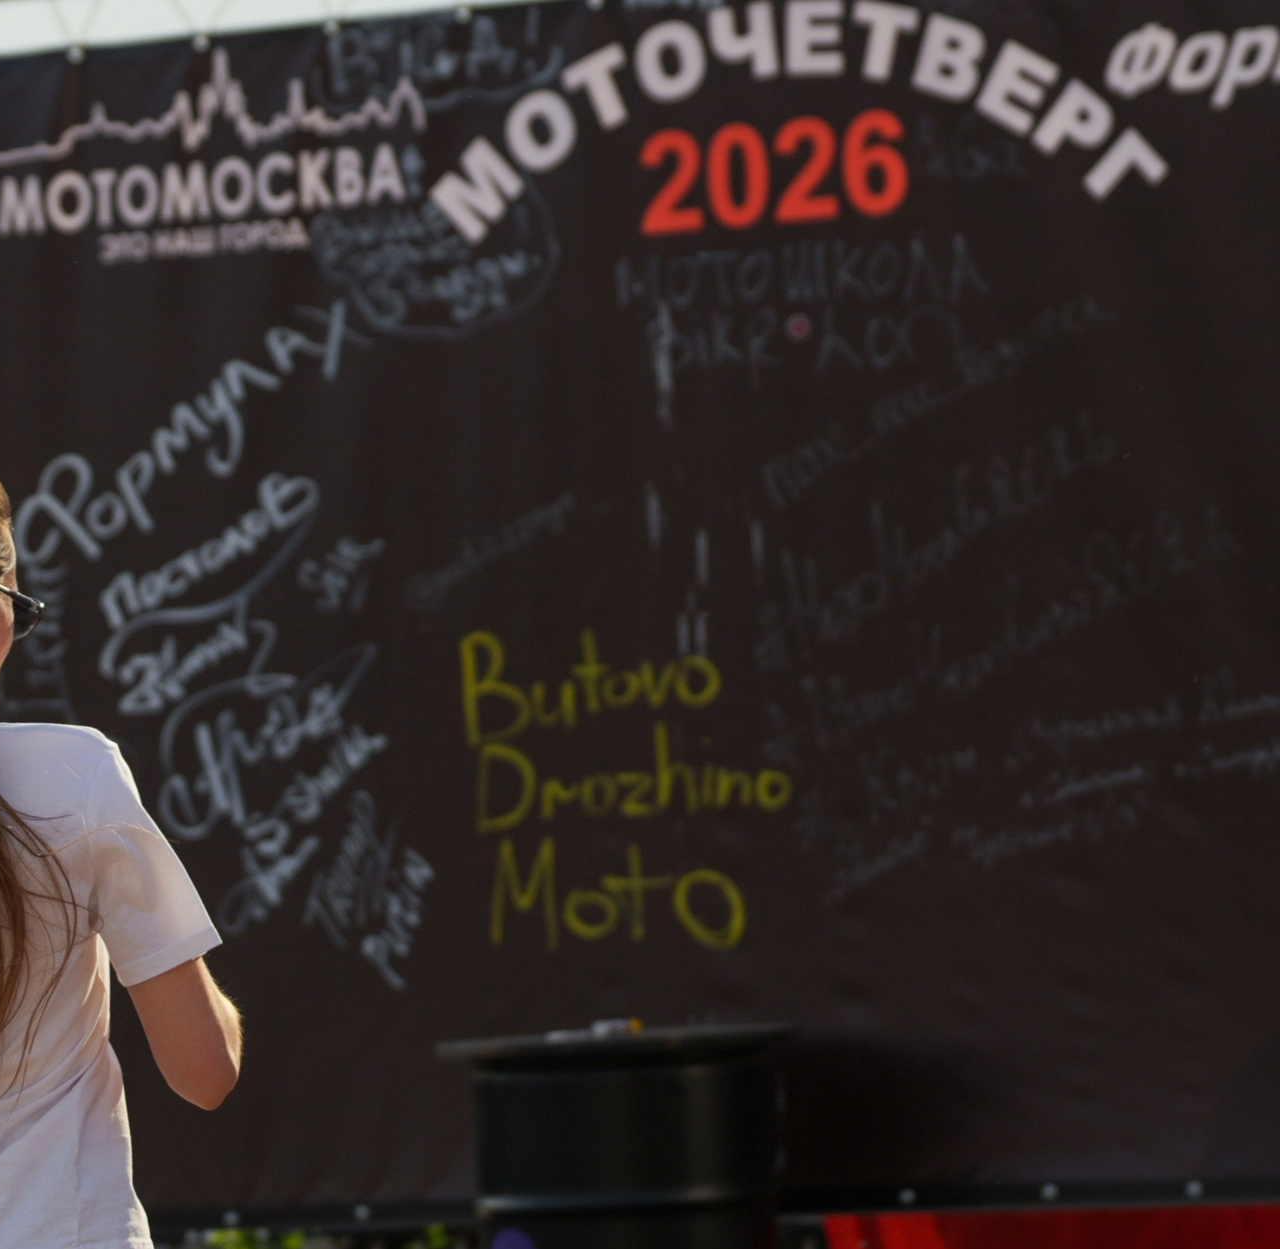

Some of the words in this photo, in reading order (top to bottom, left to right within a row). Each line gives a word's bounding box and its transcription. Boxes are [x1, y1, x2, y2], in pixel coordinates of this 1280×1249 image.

[1104, 21, 1280, 111] Фор
[638, 108, 910, 236] 2026
[460, 629, 722, 746] Butovo
[477, 721, 792, 834] Drozhino
